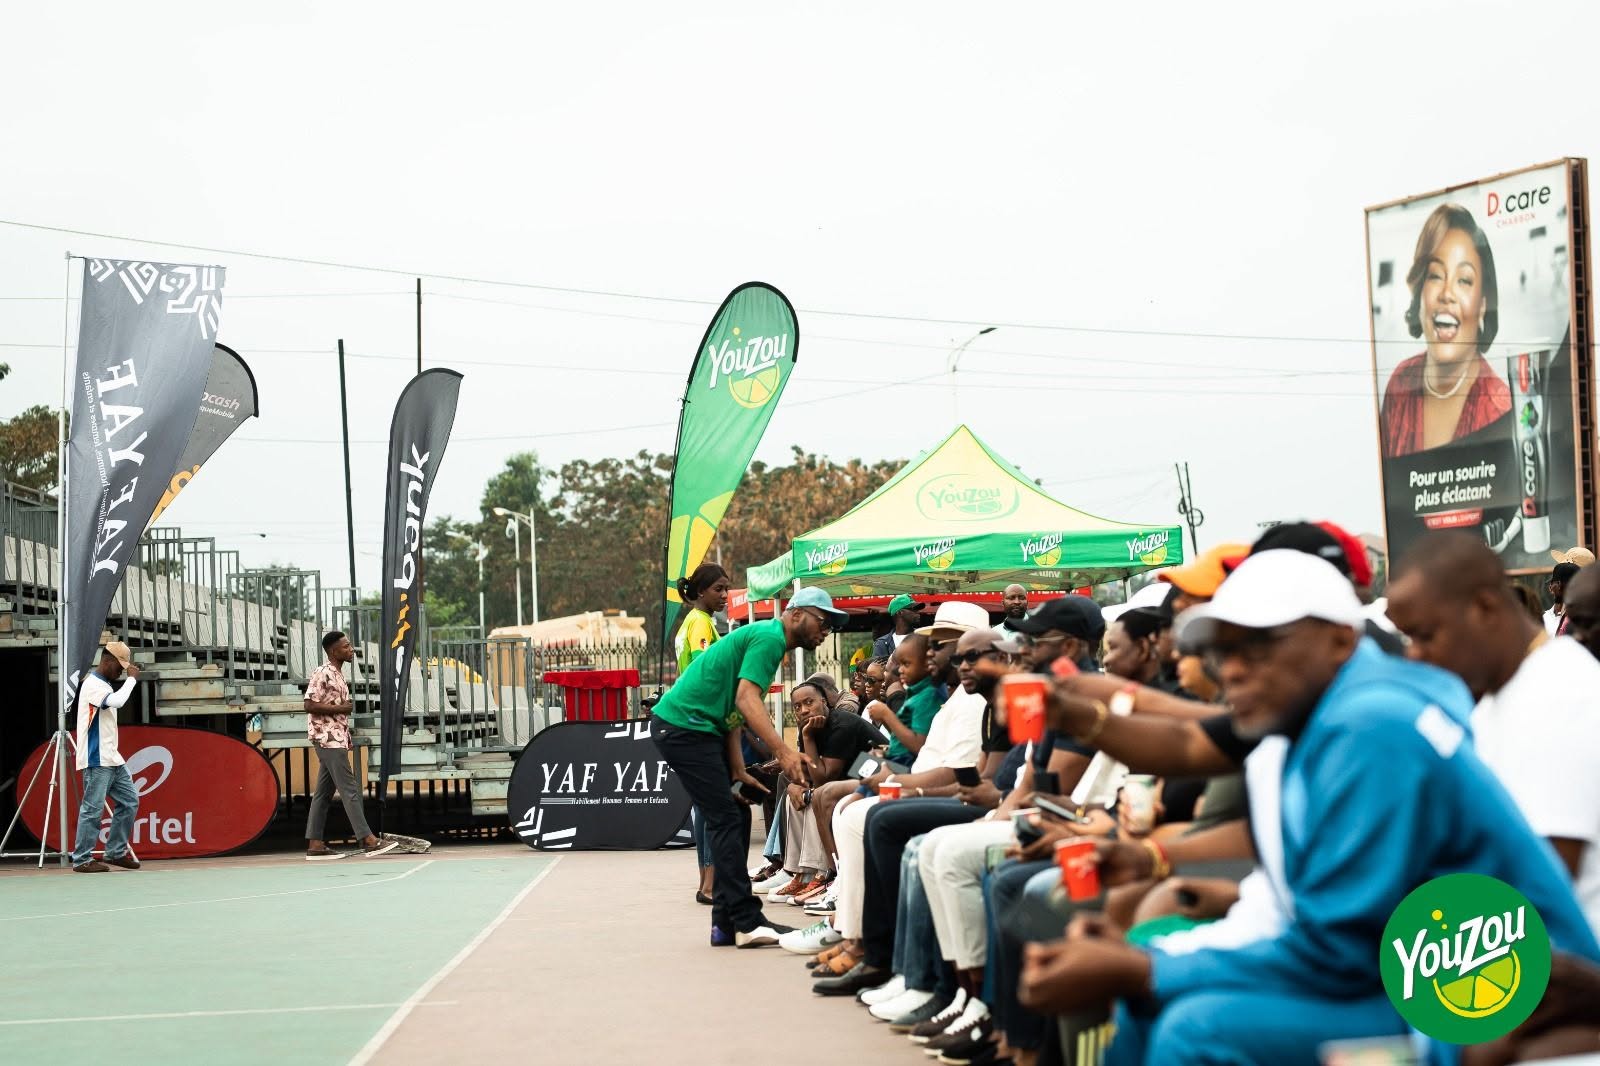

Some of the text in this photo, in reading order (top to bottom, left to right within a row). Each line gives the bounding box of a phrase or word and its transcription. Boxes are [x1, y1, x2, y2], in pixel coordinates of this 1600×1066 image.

[708, 333, 788, 390] YouZou
[1409, 460, 1497, 488] Pour un sourire
[1415, 483, 1492, 511] plus éclatant
[541, 760, 671, 794] YAF YAF
[98, 811, 197, 844] artel
